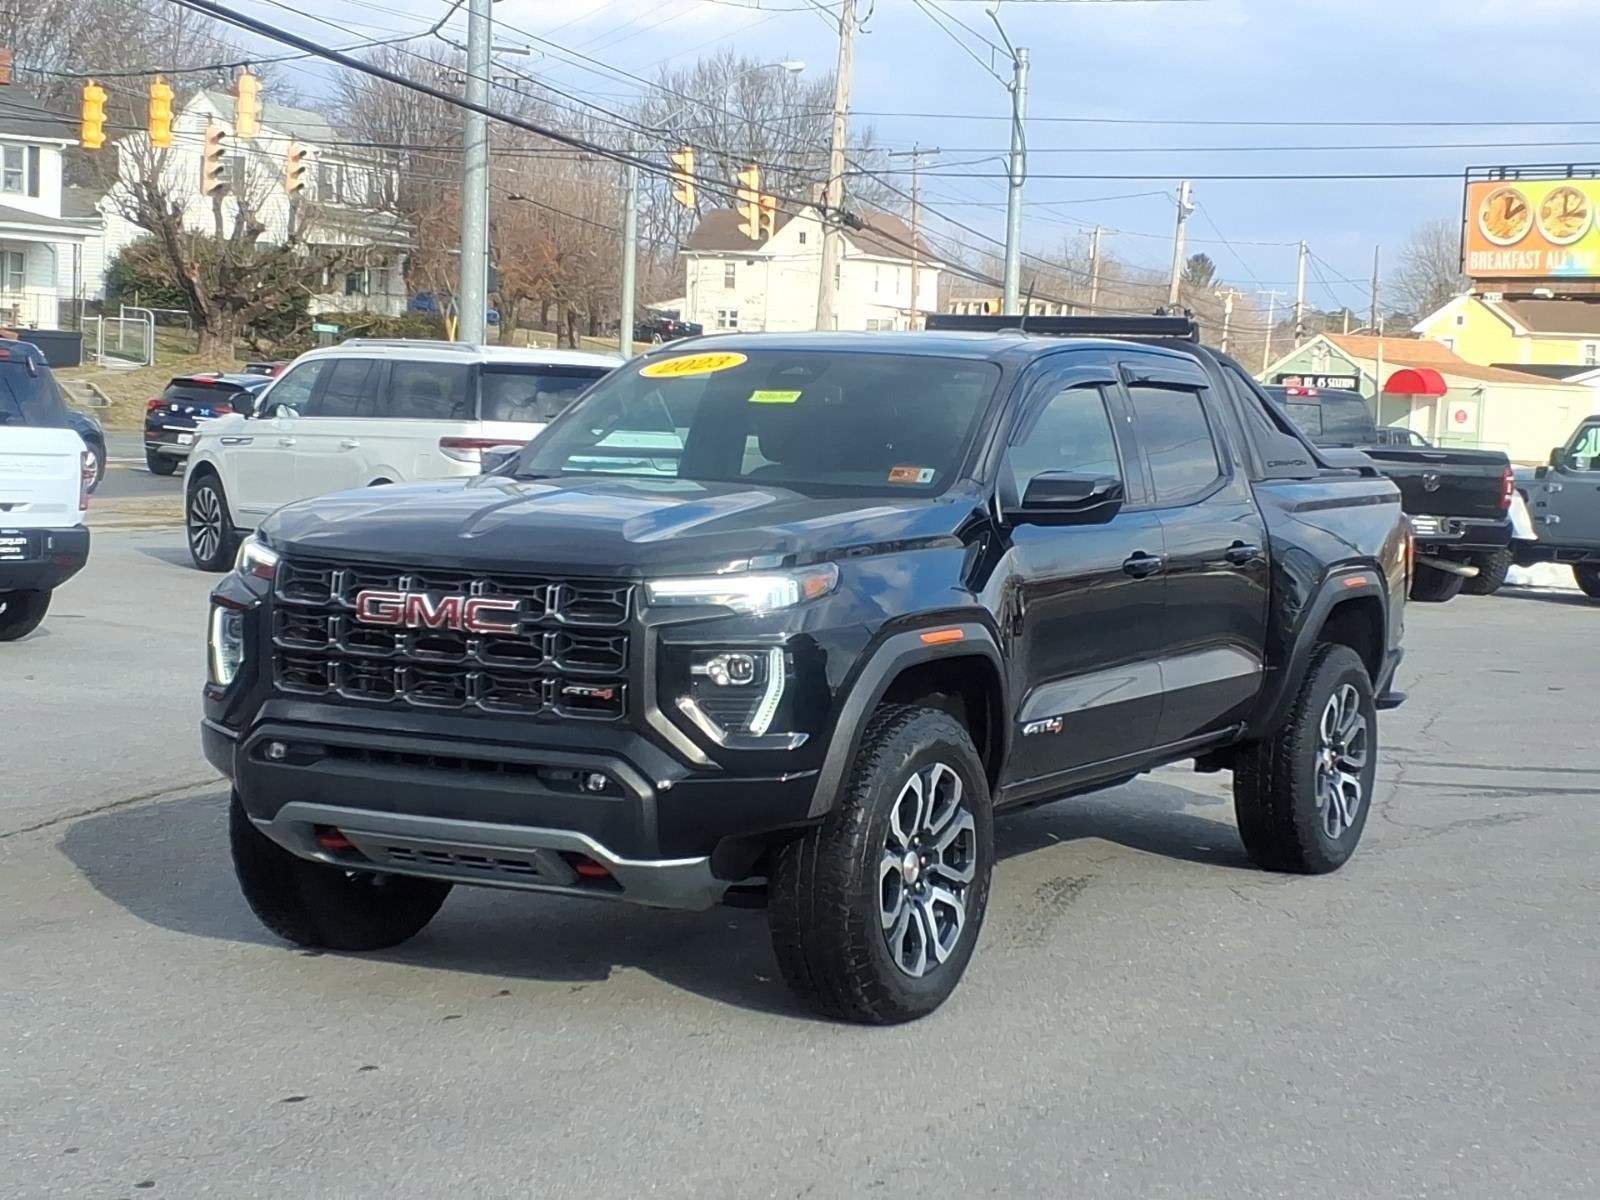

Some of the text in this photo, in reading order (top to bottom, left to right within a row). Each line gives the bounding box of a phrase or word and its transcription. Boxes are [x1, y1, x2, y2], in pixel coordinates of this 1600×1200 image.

[1470, 250, 1542, 270] BREAKFAST
[655, 354, 732, 375] 2023
[355, 590, 521, 635] GMC
[561, 686, 613, 700] AT4
[1023, 716, 1063, 737] AT4
